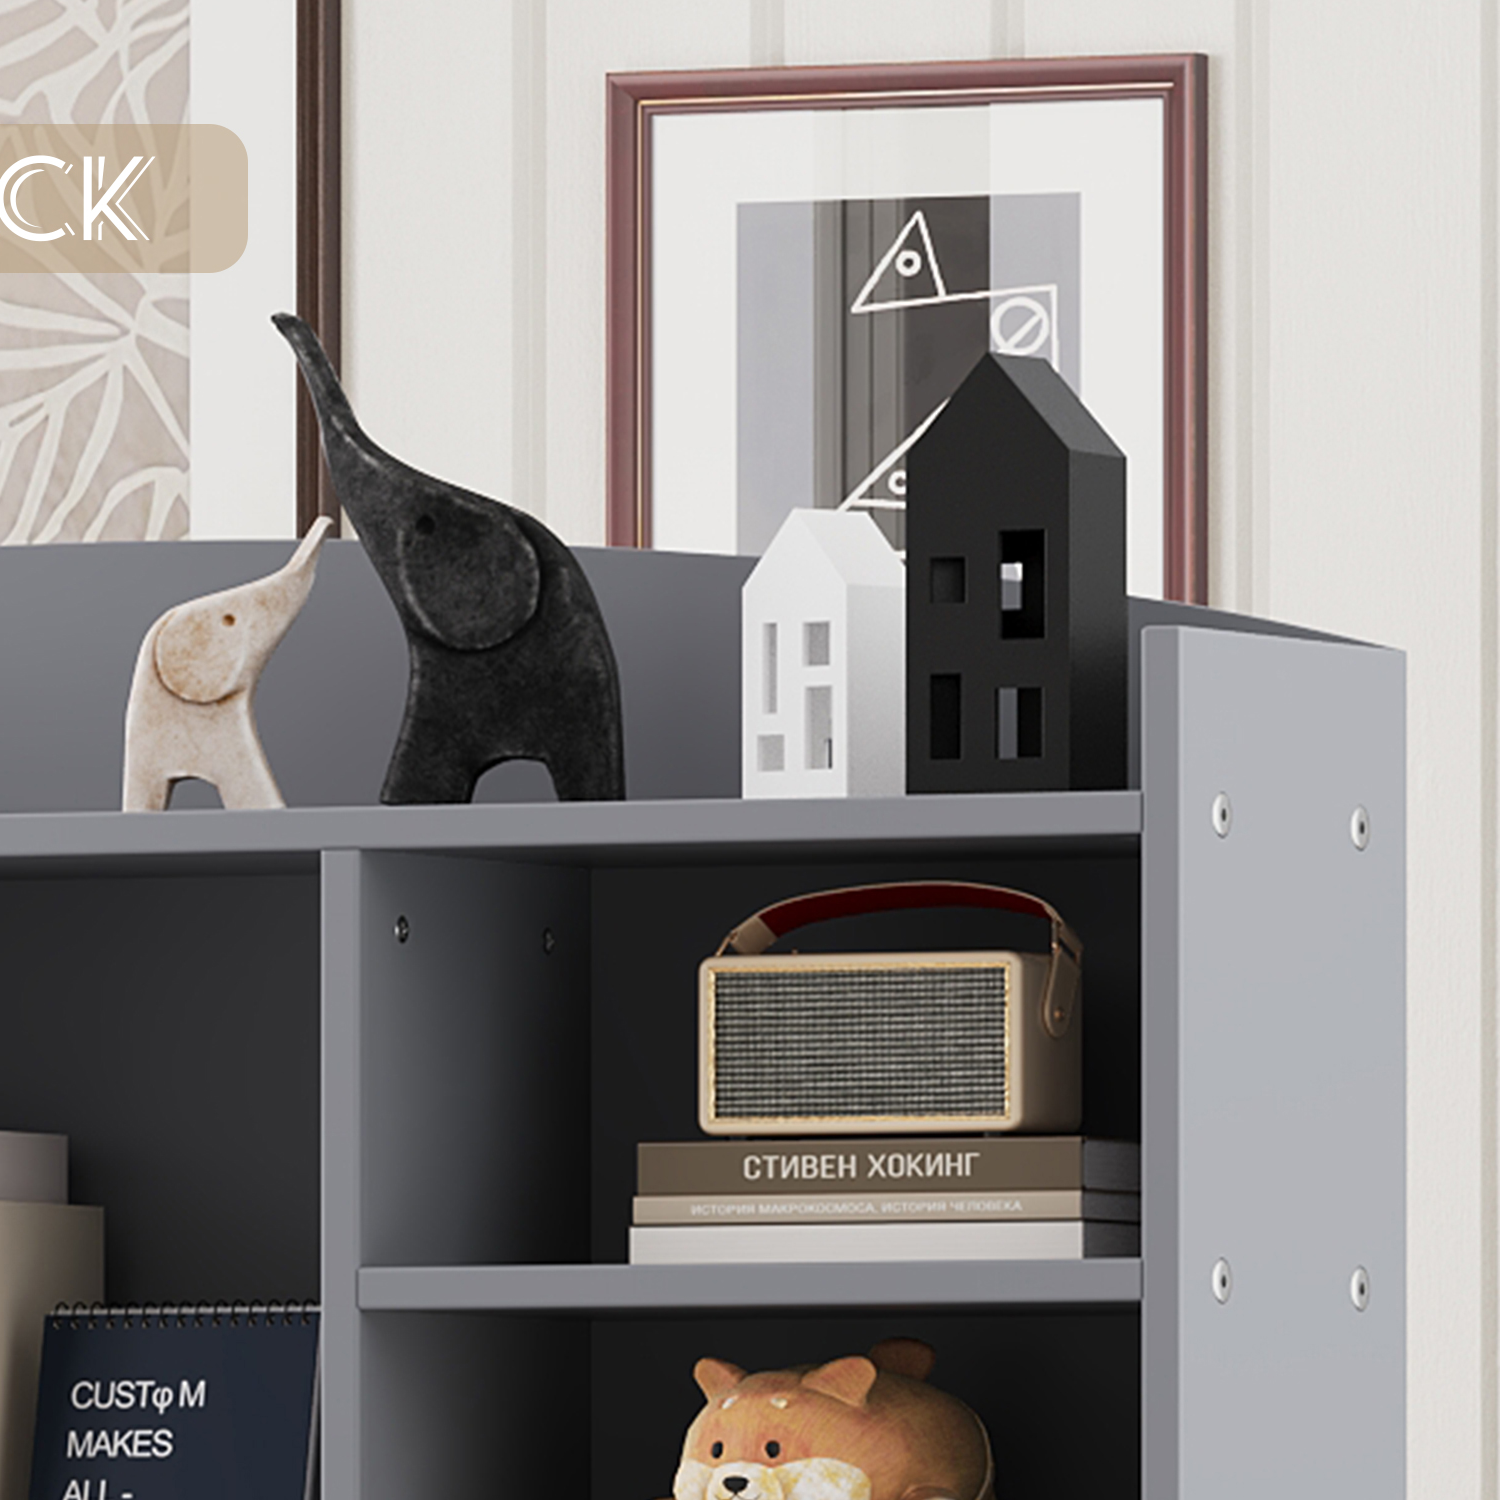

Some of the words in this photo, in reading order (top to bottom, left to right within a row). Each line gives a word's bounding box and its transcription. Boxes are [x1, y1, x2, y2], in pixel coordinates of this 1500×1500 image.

[743, 1154, 857, 1180] СТИВЕН
[867, 1152, 981, 1178] ХОКИНГ
[690, 1203, 756, 1216] ИСТОРИЯ
[881, 1202, 946, 1214] ИСТОРИЯ
[67, 1428, 173, 1458] MAKES
